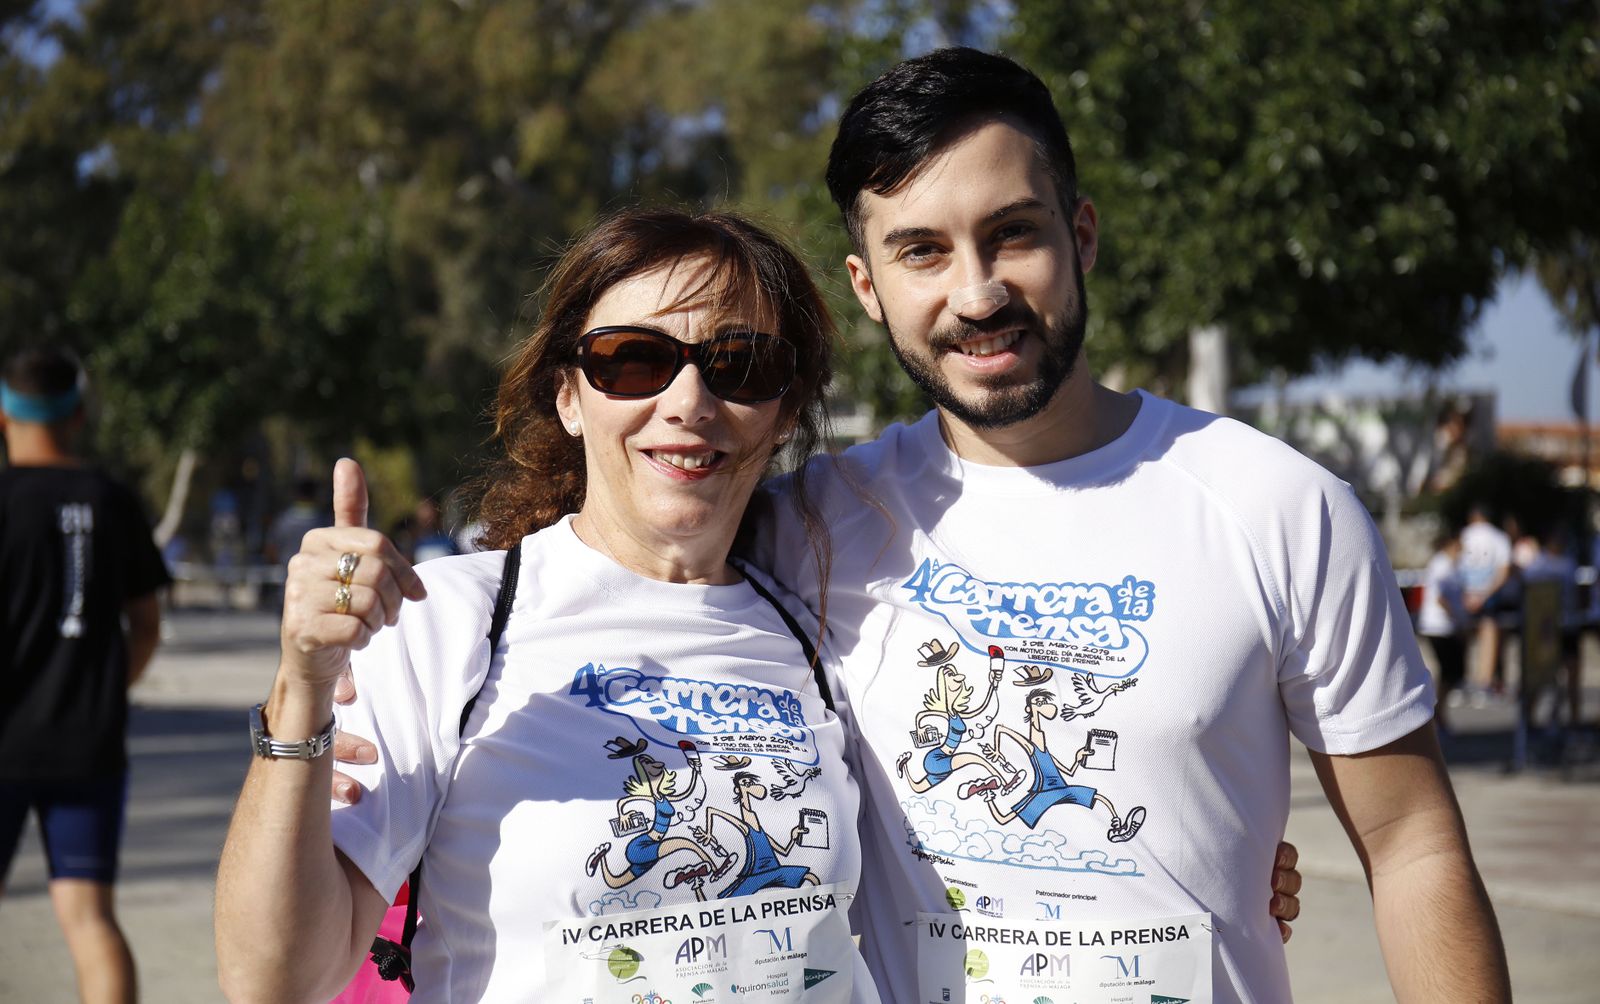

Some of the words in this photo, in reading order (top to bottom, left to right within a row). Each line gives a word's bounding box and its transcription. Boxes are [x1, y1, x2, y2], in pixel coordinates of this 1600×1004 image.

[931, 572, 1114, 615] Carrera
[1116, 580, 1149, 599] de
[1019, 647, 1045, 655] MOTIVO
[1046, 649, 1059, 657] DEL
[1074, 652, 1103, 661] MUNDIAL
[1028, 654, 1059, 663] LIBERTAD
[1072, 657, 1100, 666] PRENSA
[606, 674, 781, 721] Carrera
[976, 895, 1004, 912] APM
[588, 914, 694, 942] CARRERA
[700, 911, 726, 928] DE
[731, 905, 757, 923] LA
[761, 893, 837, 920] PRENSA
[929, 922, 946, 938] IV
[951, 924, 1039, 947] CARRERA
[1045, 931, 1071, 947] DE
[1079, 930, 1105, 947] LA
[1111, 925, 1190, 946] PRENSA
[675, 932, 727, 965] APM
[754, 955, 780, 965] diputación
[787, 952, 808, 961] málaga
[1020, 953, 1070, 977] APM
